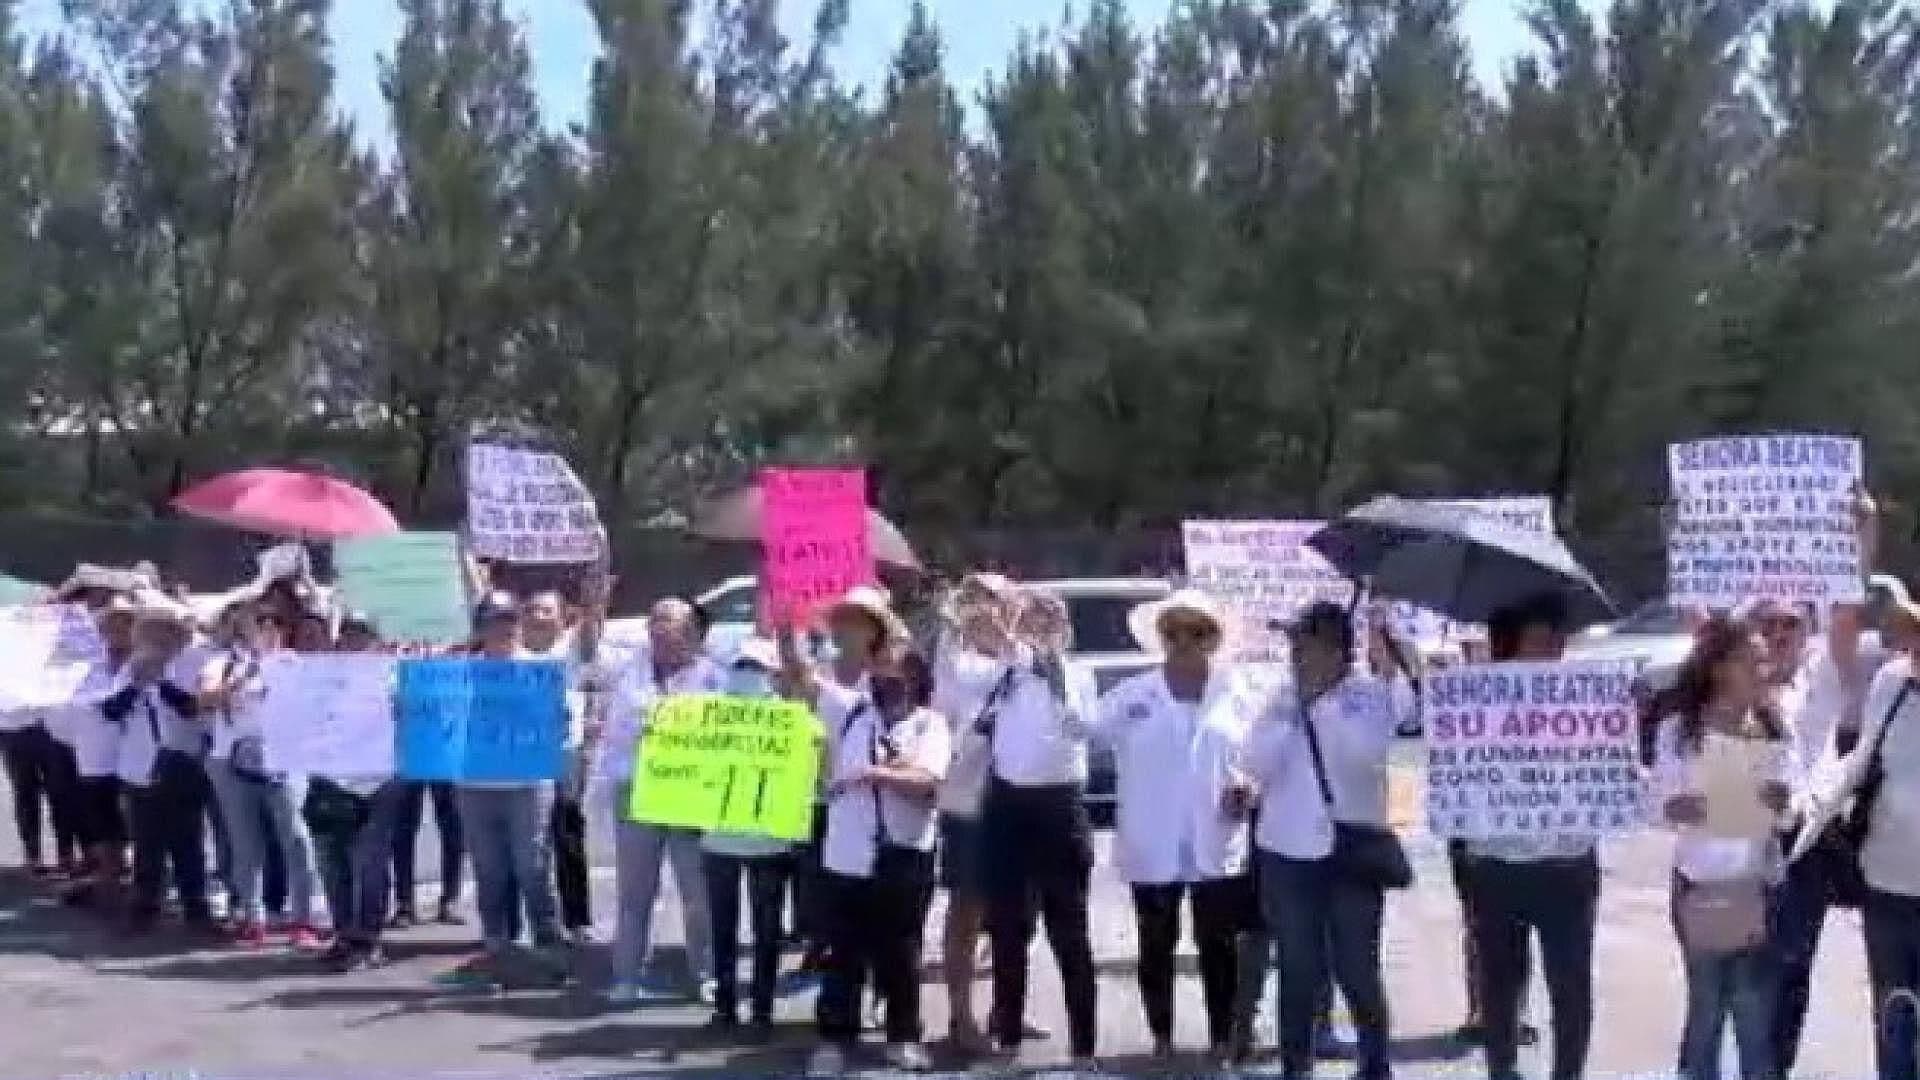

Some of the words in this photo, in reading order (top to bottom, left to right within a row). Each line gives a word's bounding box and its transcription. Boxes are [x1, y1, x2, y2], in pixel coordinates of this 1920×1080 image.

[1532, 672, 1630, 704] BEATRIZ
[1434, 710, 1486, 739] SU
[1501, 709, 1628, 738] APOYO
[1464, 745, 1633, 763] FUNDAMENTAL
[1428, 767, 1504, 786] COMO
[1519, 766, 1639, 785] MUJERES
